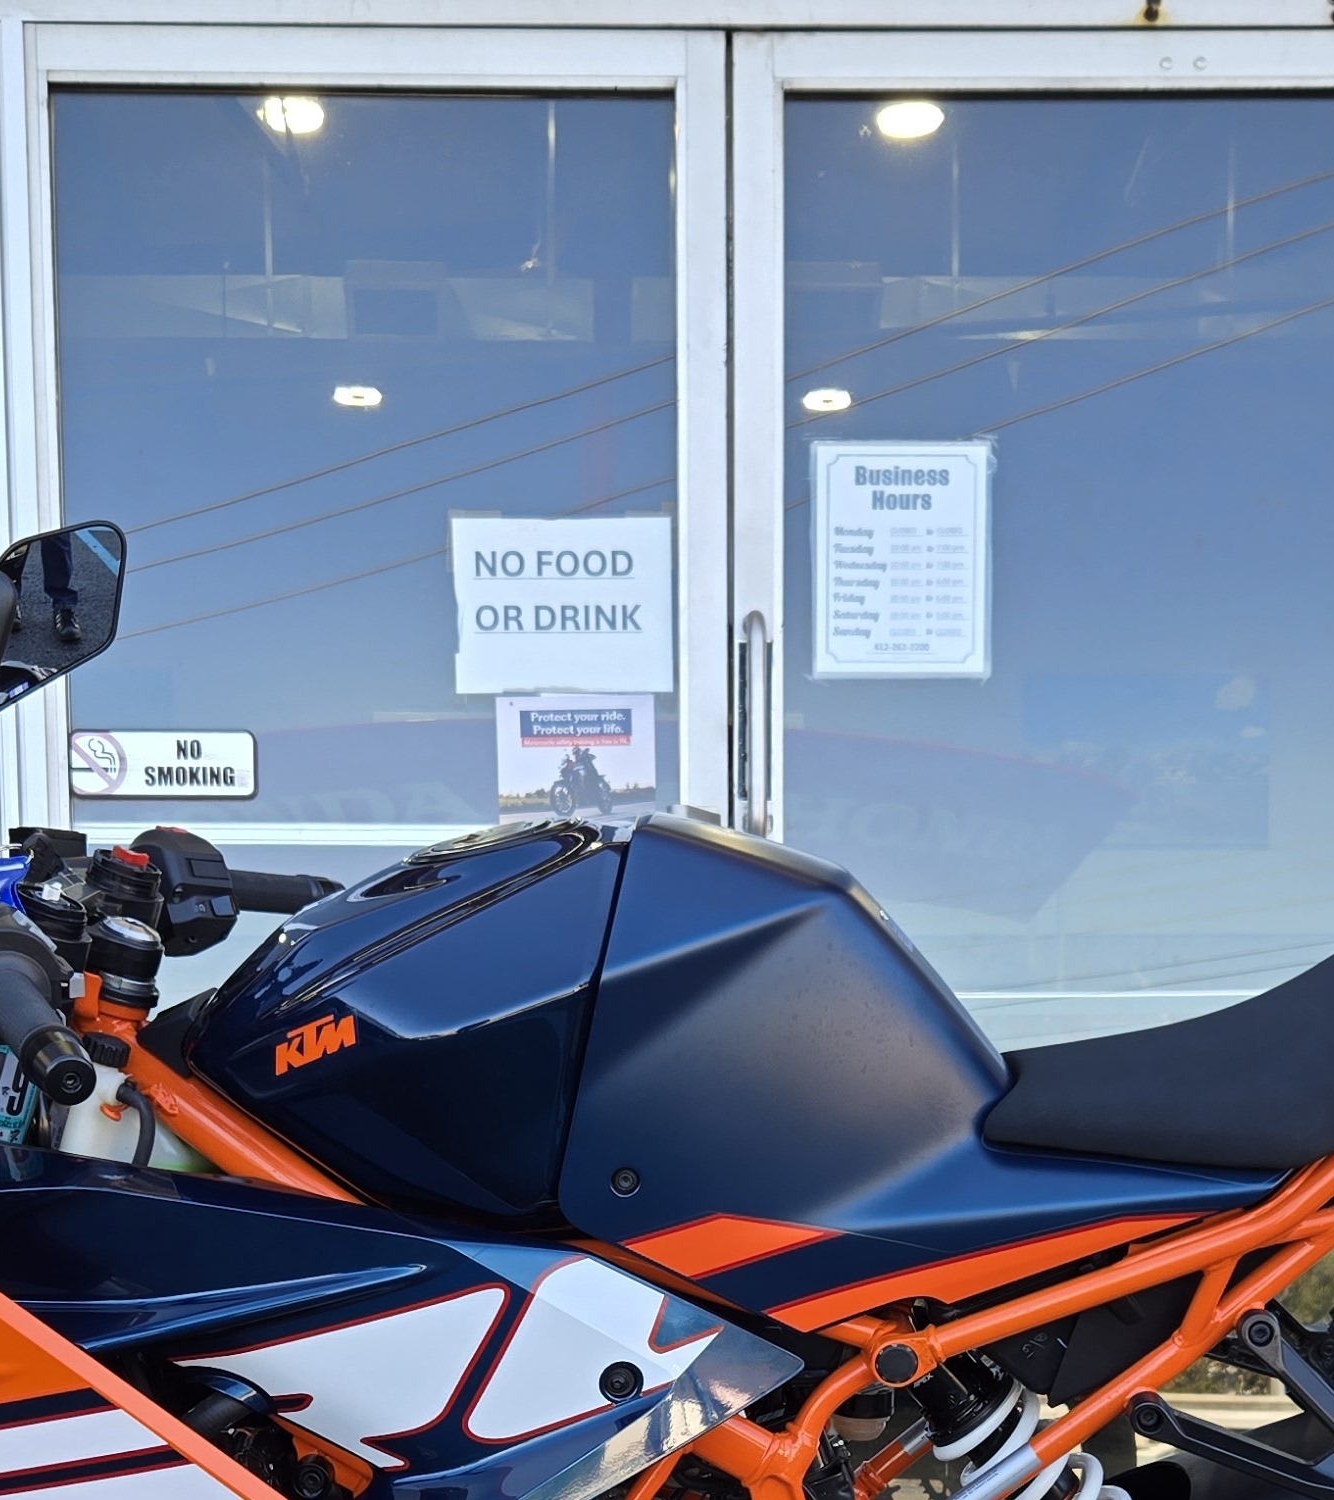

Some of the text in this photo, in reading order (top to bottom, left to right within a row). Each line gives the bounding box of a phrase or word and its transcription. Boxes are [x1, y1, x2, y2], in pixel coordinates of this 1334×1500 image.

[854, 465, 950, 487] Business
[871, 490, 933, 511] Hours
[474, 549, 635, 578] NO FOOD
[475, 604, 643, 632] OR DRINK
[530, 711, 626, 724] Protect your ride.
[532, 724, 625, 737] Protect your life.
[176, 739, 203, 760] NO
[144, 766, 236, 787] SMOKING
[275, 1014, 357, 1077] KTM
